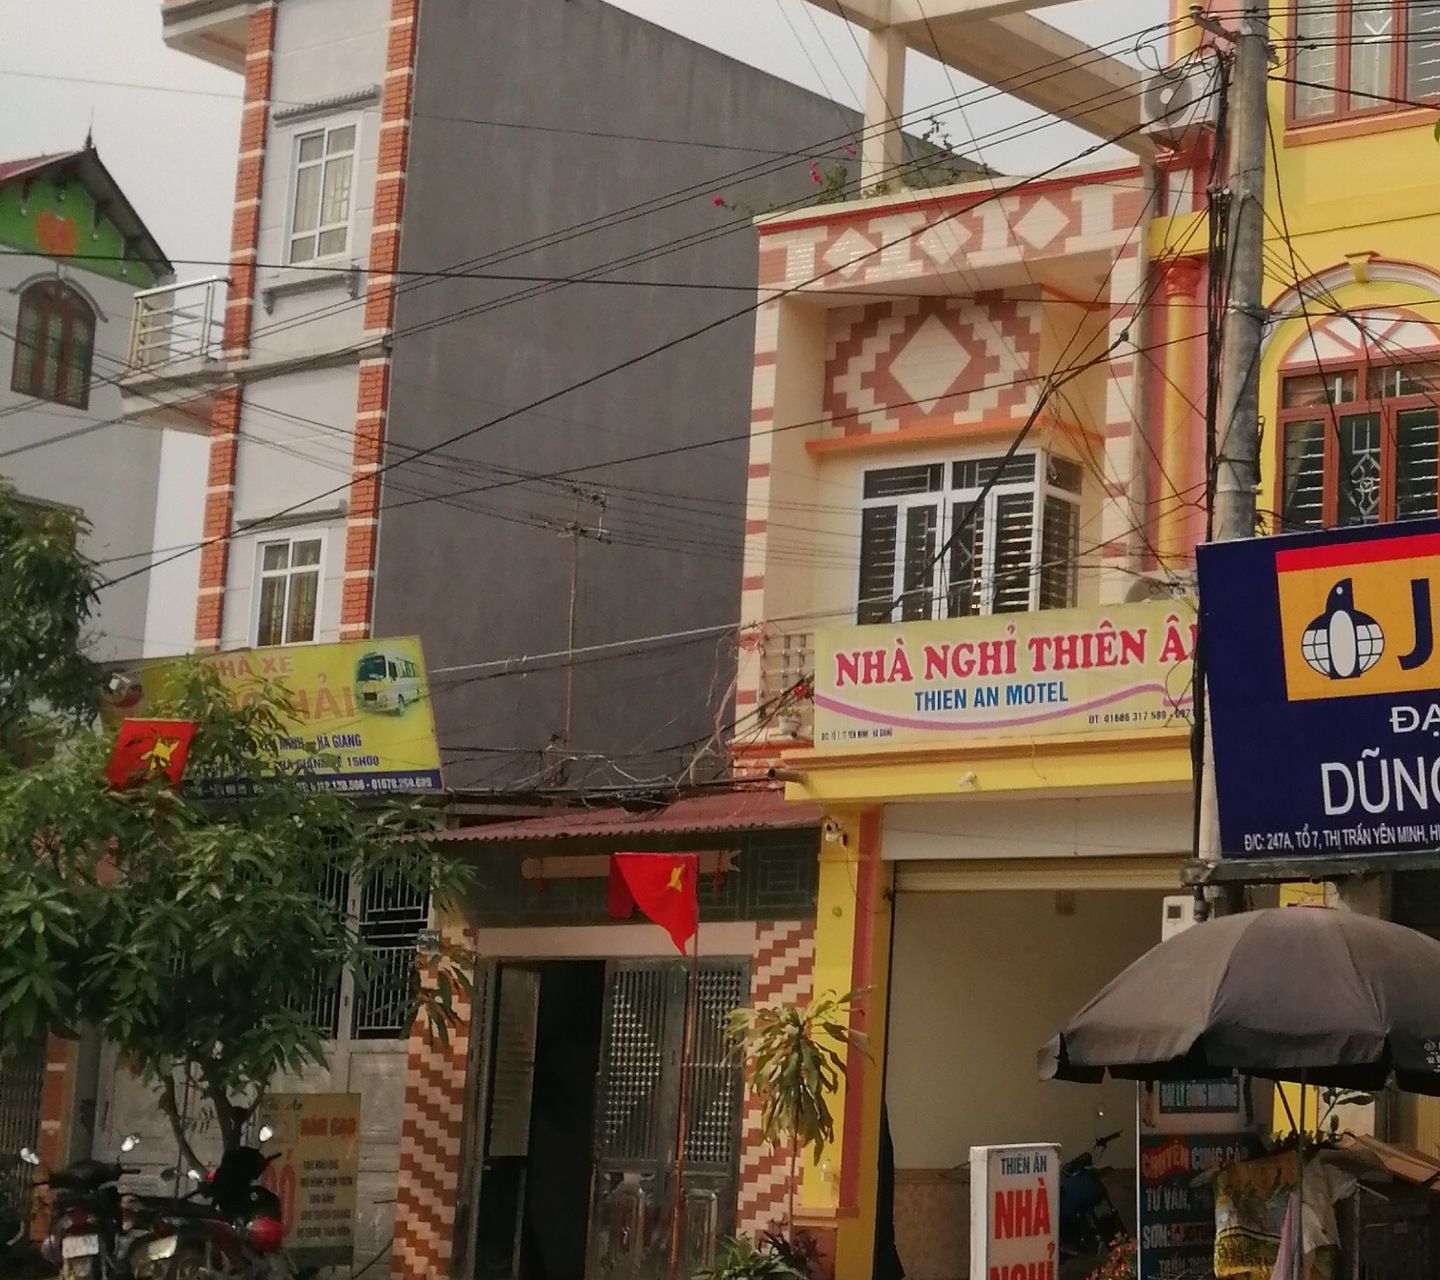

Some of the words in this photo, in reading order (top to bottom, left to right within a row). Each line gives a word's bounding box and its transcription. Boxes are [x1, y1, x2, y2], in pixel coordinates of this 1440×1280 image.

[261, 656, 294, 674] XE
[835, 637, 914, 688] NHÀ
[923, 623, 1019, 680] NGHỈ
[1028, 621, 1149, 672] THIÊN
[914, 686, 967, 712] THIEN
[973, 684, 1000, 709] AN
[1005, 680, 1070, 707] MOTEL
[332, 733, 362, 749] GIANG
[1244, 834, 1265, 851] Đ/C:
[1266, 832, 1294, 851] 247A,
[1295, 824, 1311, 849] TỔ
[1312, 830, 1322, 850] 7,
[1323, 829, 1341, 850] THỊ
[1341, 822, 1372, 846] TRẤN
[1372, 822, 1396, 845] YÊN
[1397, 825, 1429, 845] MINH,
[1000, 1154, 1030, 1176] THIÊN
[1033, 1151, 1048, 1174] ÂN
[994, 1178, 1051, 1240] NHÀ
